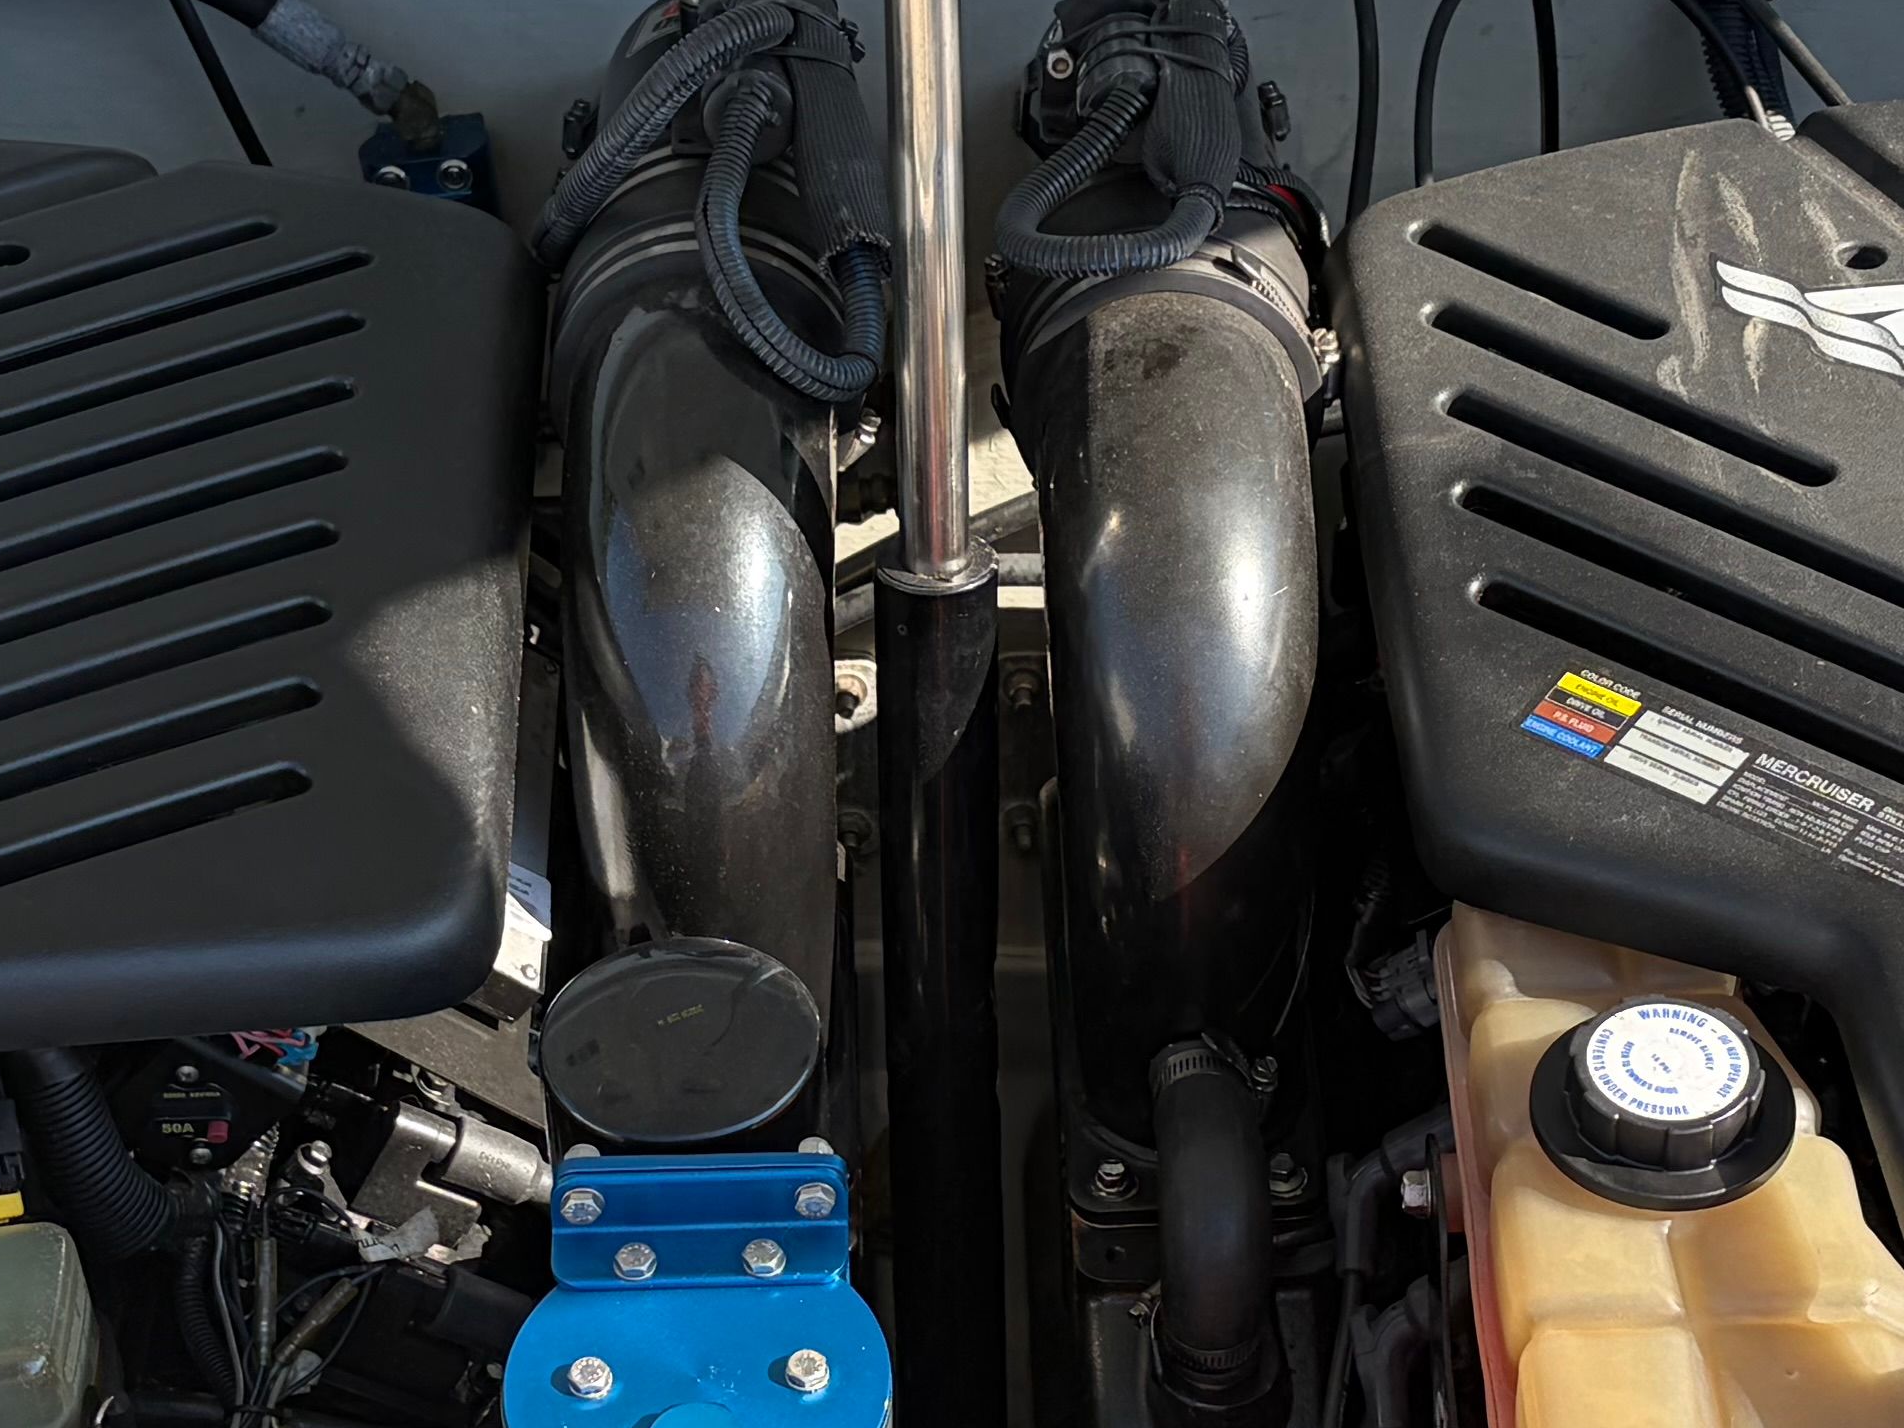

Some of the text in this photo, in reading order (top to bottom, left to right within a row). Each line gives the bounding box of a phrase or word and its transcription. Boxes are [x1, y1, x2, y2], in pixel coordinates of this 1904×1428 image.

[1753, 751, 1878, 812] MERCRUISER
[1637, 1008, 1708, 1029] WARNING
[1592, 1028, 1690, 1116] CONTENTS UNDER PRESSURE
